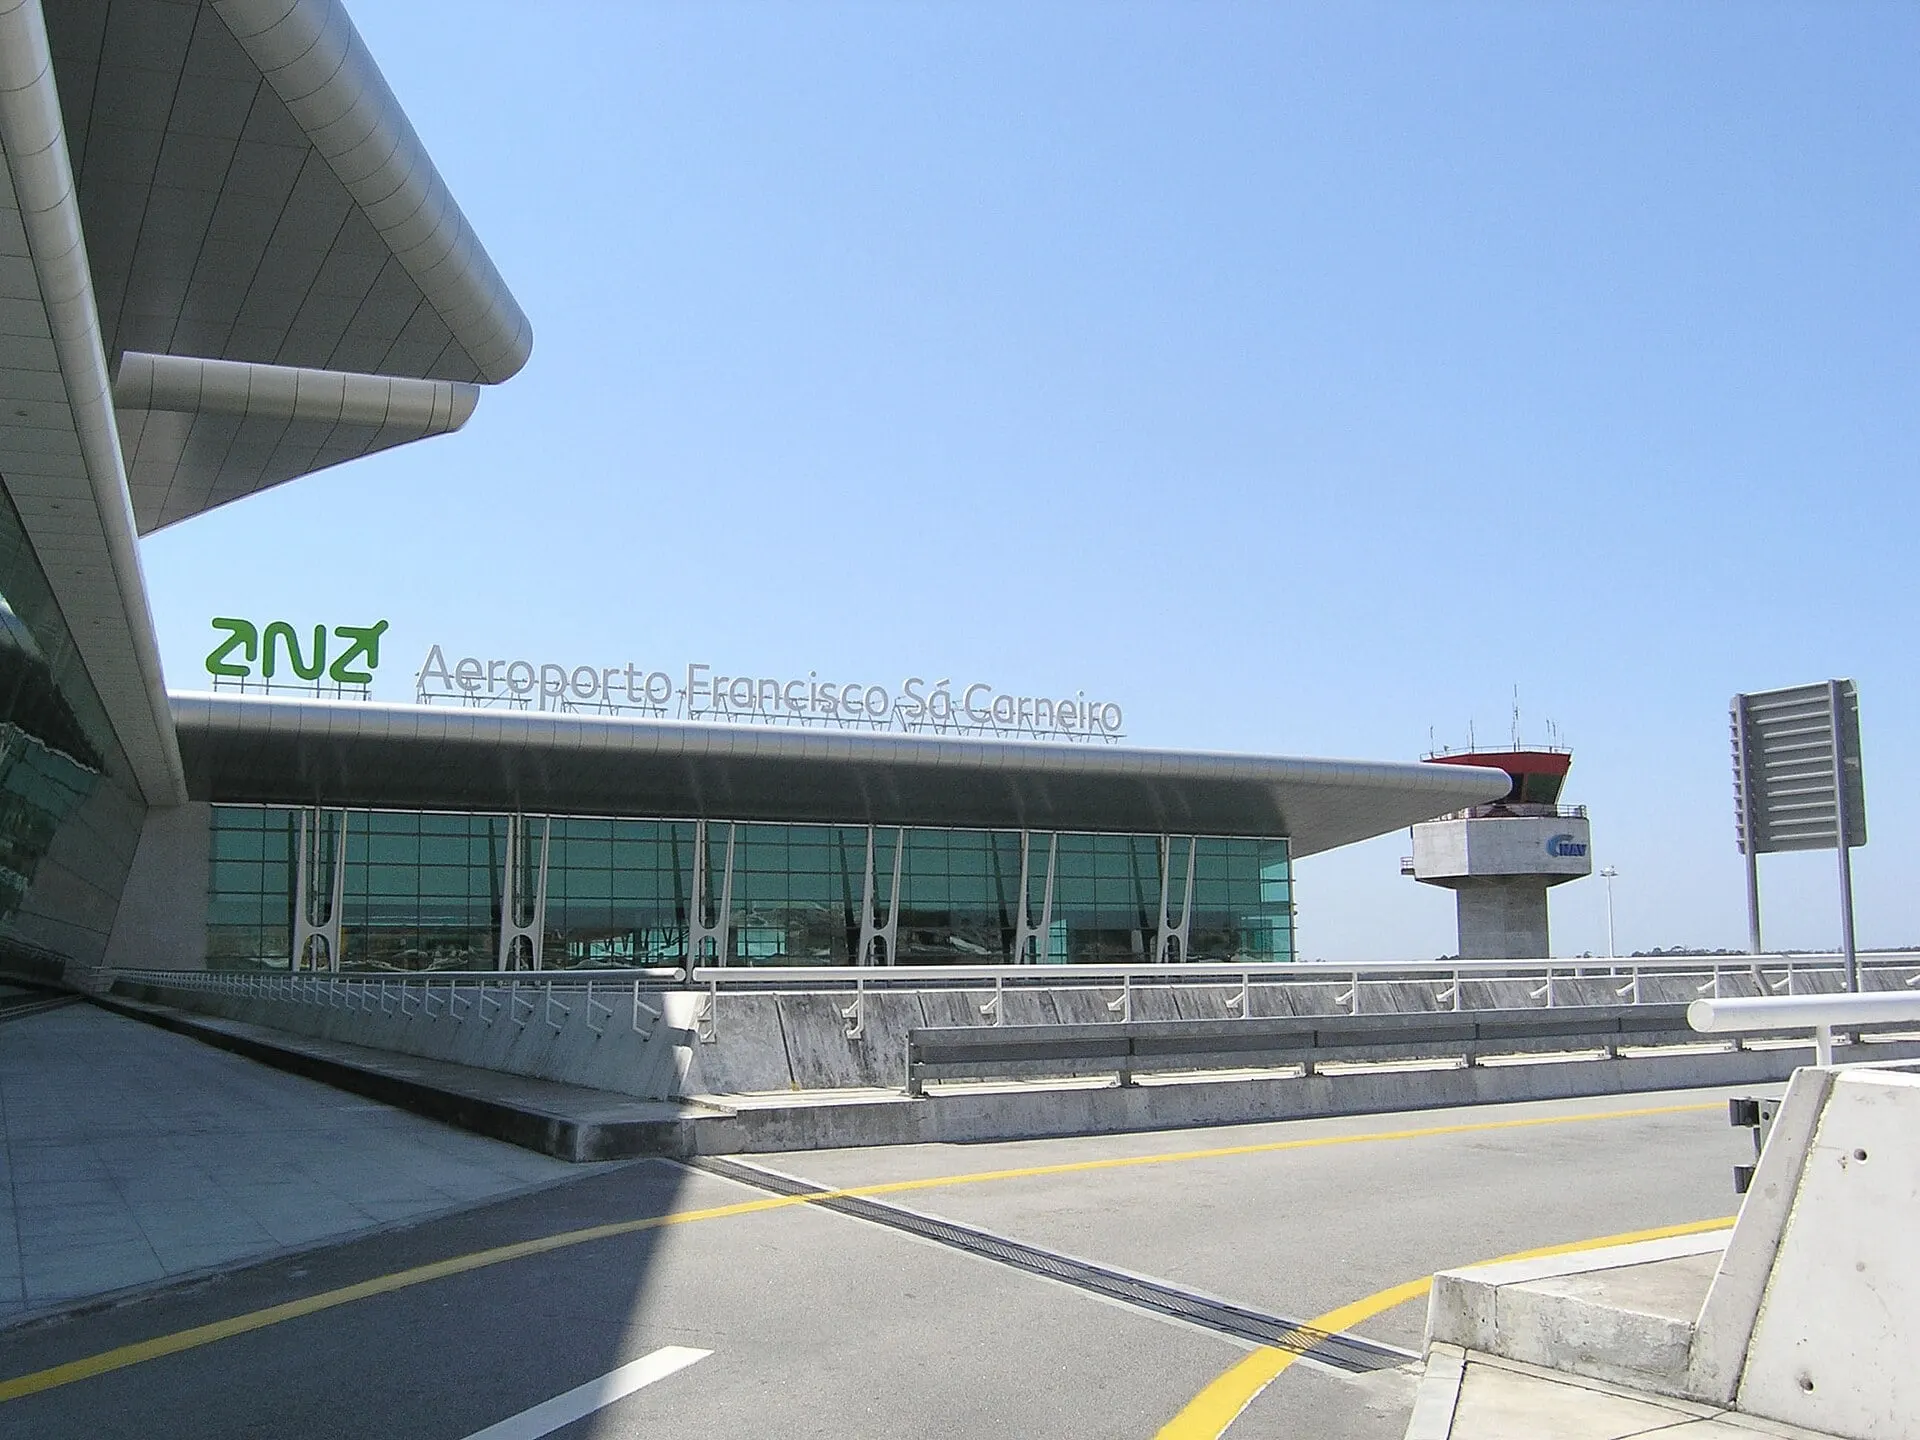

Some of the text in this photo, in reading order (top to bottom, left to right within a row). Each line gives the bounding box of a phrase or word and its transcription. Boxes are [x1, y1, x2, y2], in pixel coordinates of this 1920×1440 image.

[416, 644, 1122, 732] Aeroporto Francisco Sá Carneiro
